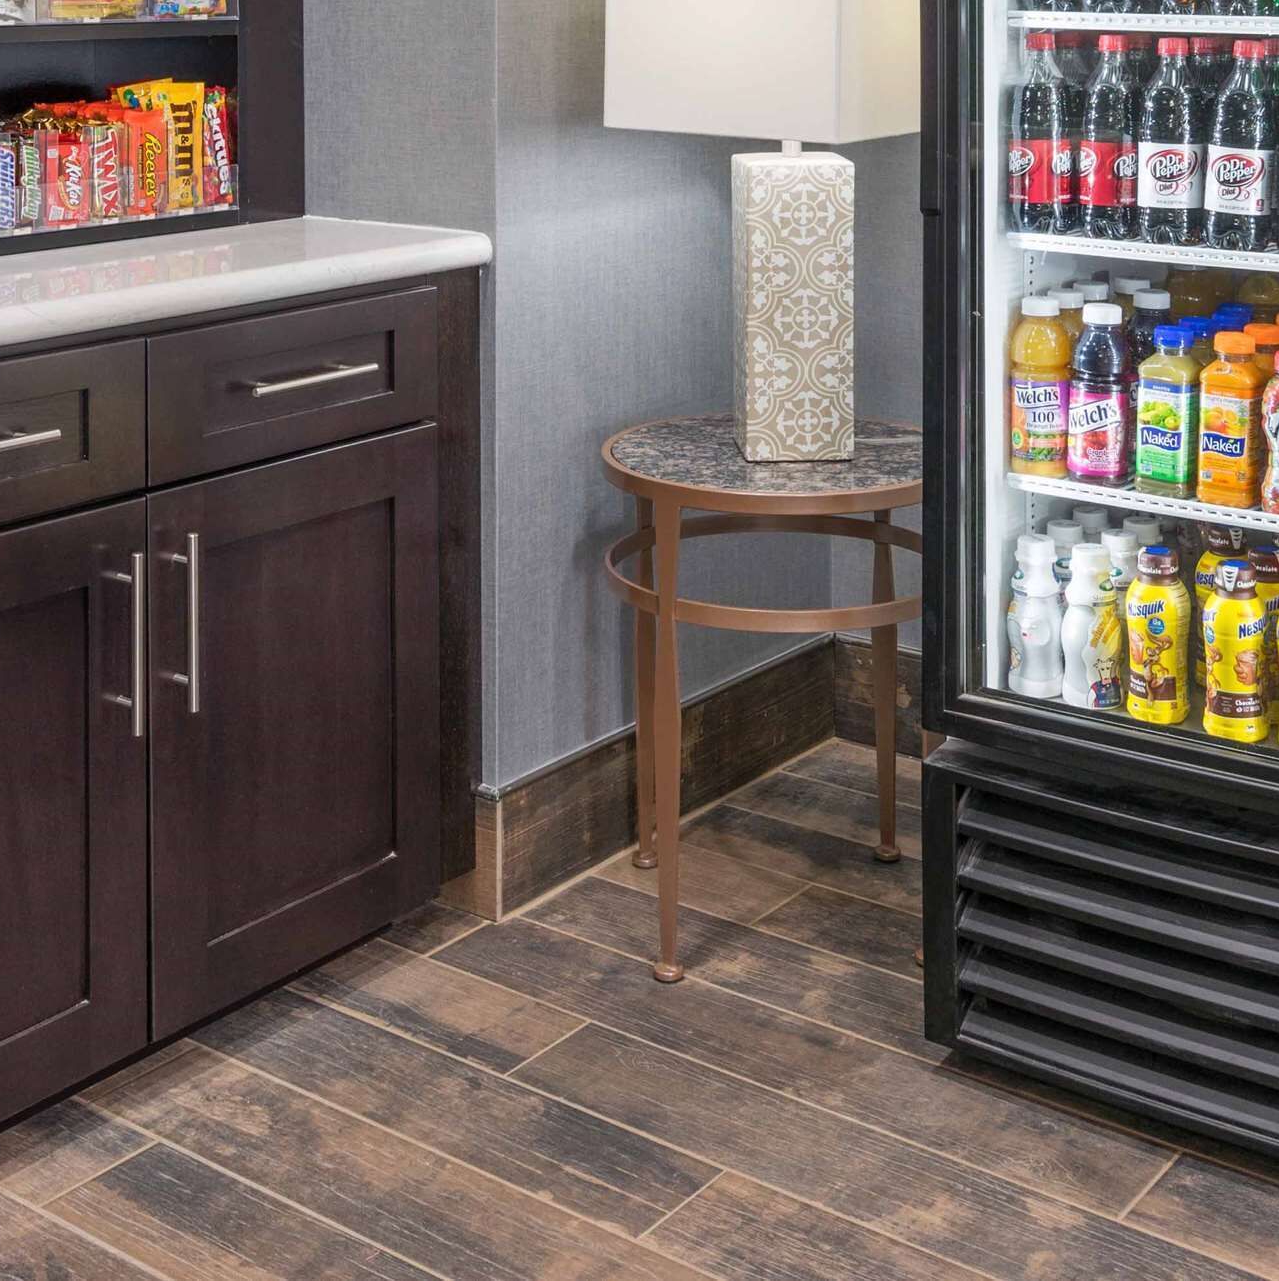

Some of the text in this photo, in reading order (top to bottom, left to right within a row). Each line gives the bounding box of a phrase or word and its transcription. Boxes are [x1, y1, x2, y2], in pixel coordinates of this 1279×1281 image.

[144, 132, 162, 198] Reese's
[1167, 151, 1183, 166] Dr
[1230, 159, 1247, 171] Dr
[91, 129, 118, 216] TWIX
[1152, 159, 1191, 181] Pepper
[1218, 165, 1257, 184] Pepper
[0, 148, 15, 227] SNICKERS
[1158, 182, 1175, 192] Diet
[1221, 186, 1238, 197] Diet
[1016, 388, 1059, 403] Welch's
[1032, 411, 1055, 423] 100
[1142, 430, 1179, 447] Naked
[1203, 437, 1241, 454] Naked
